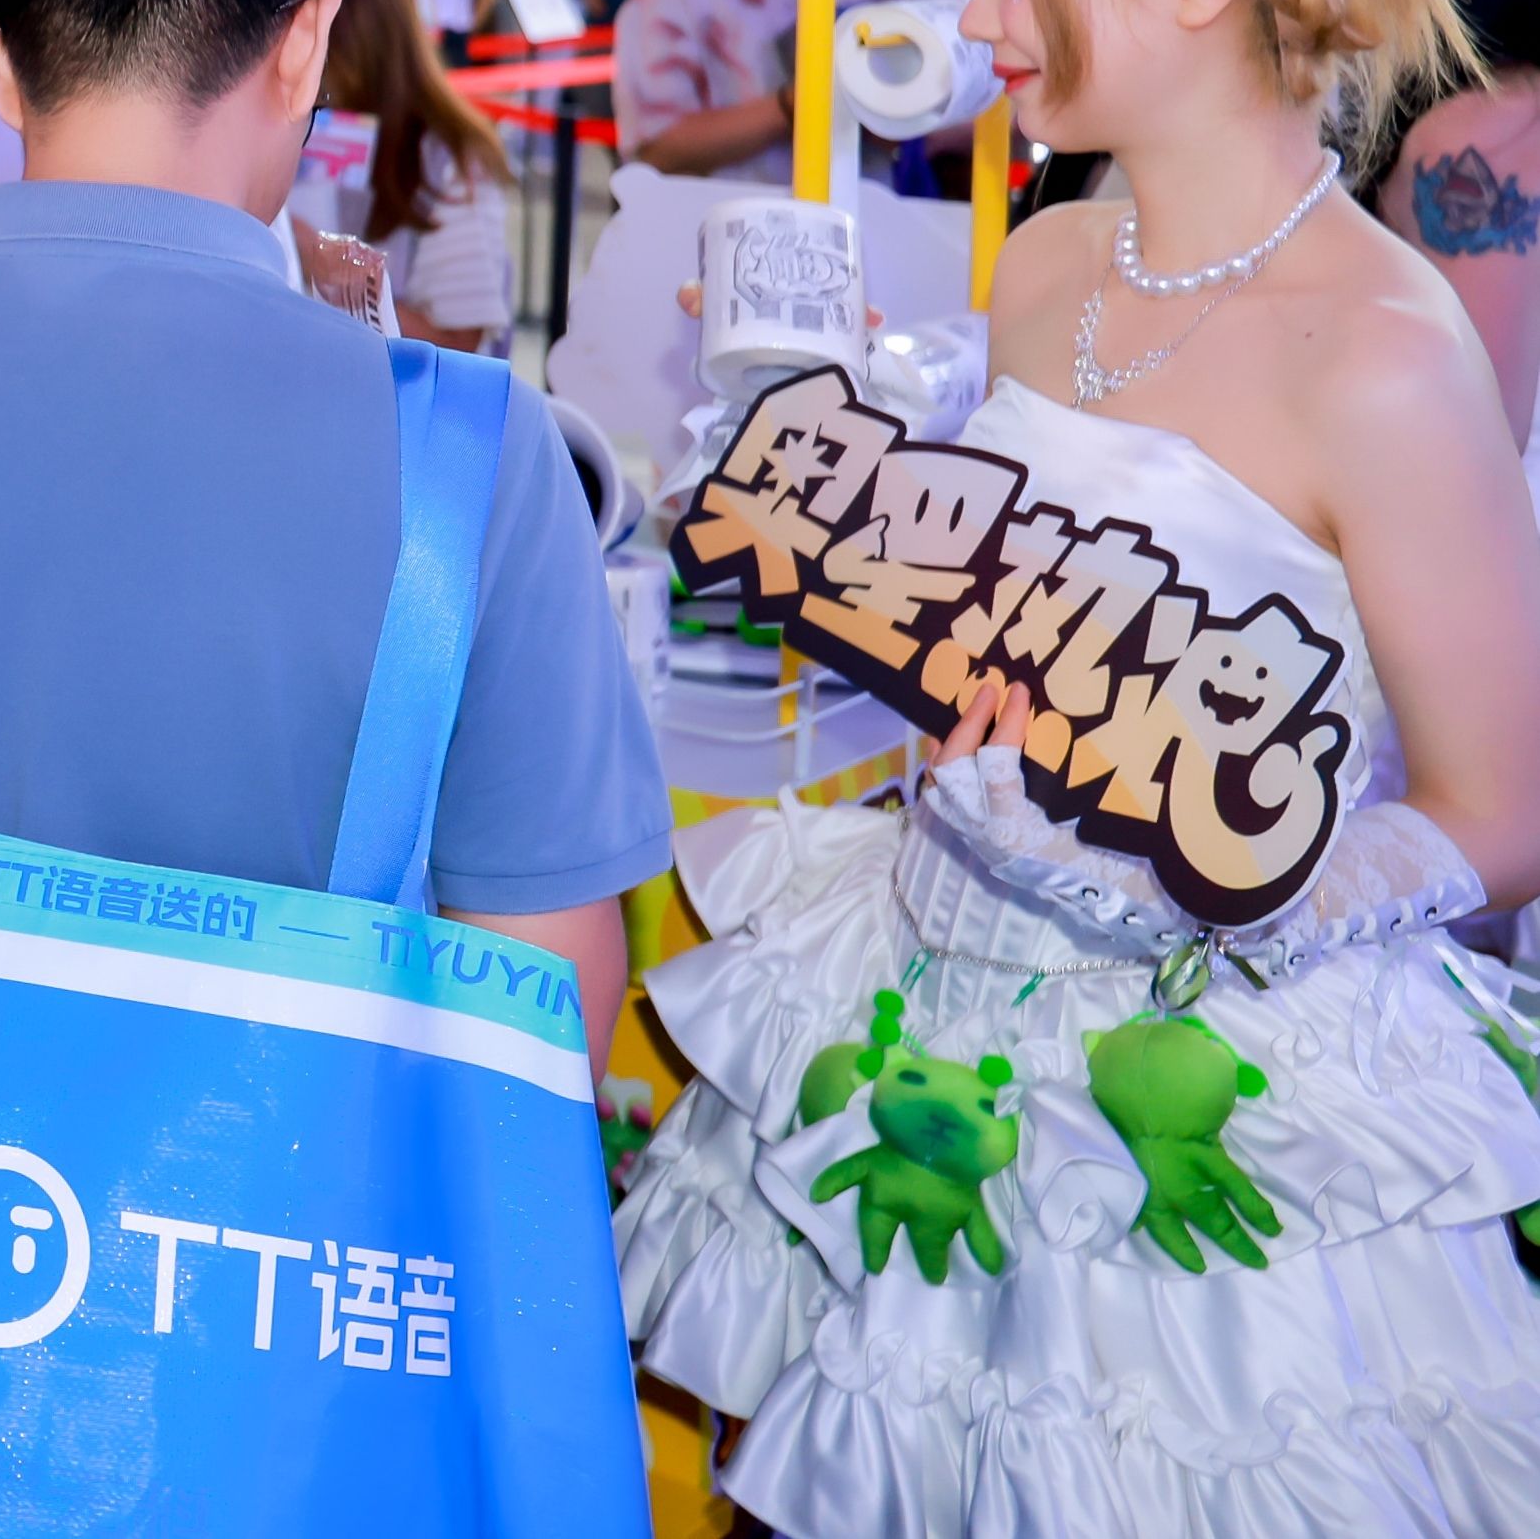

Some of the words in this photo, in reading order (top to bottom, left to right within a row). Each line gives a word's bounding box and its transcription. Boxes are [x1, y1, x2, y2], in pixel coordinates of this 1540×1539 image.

[685, 370, 1338, 890] 奥星热浪
[121, 1211, 456, 1377] TT语音
